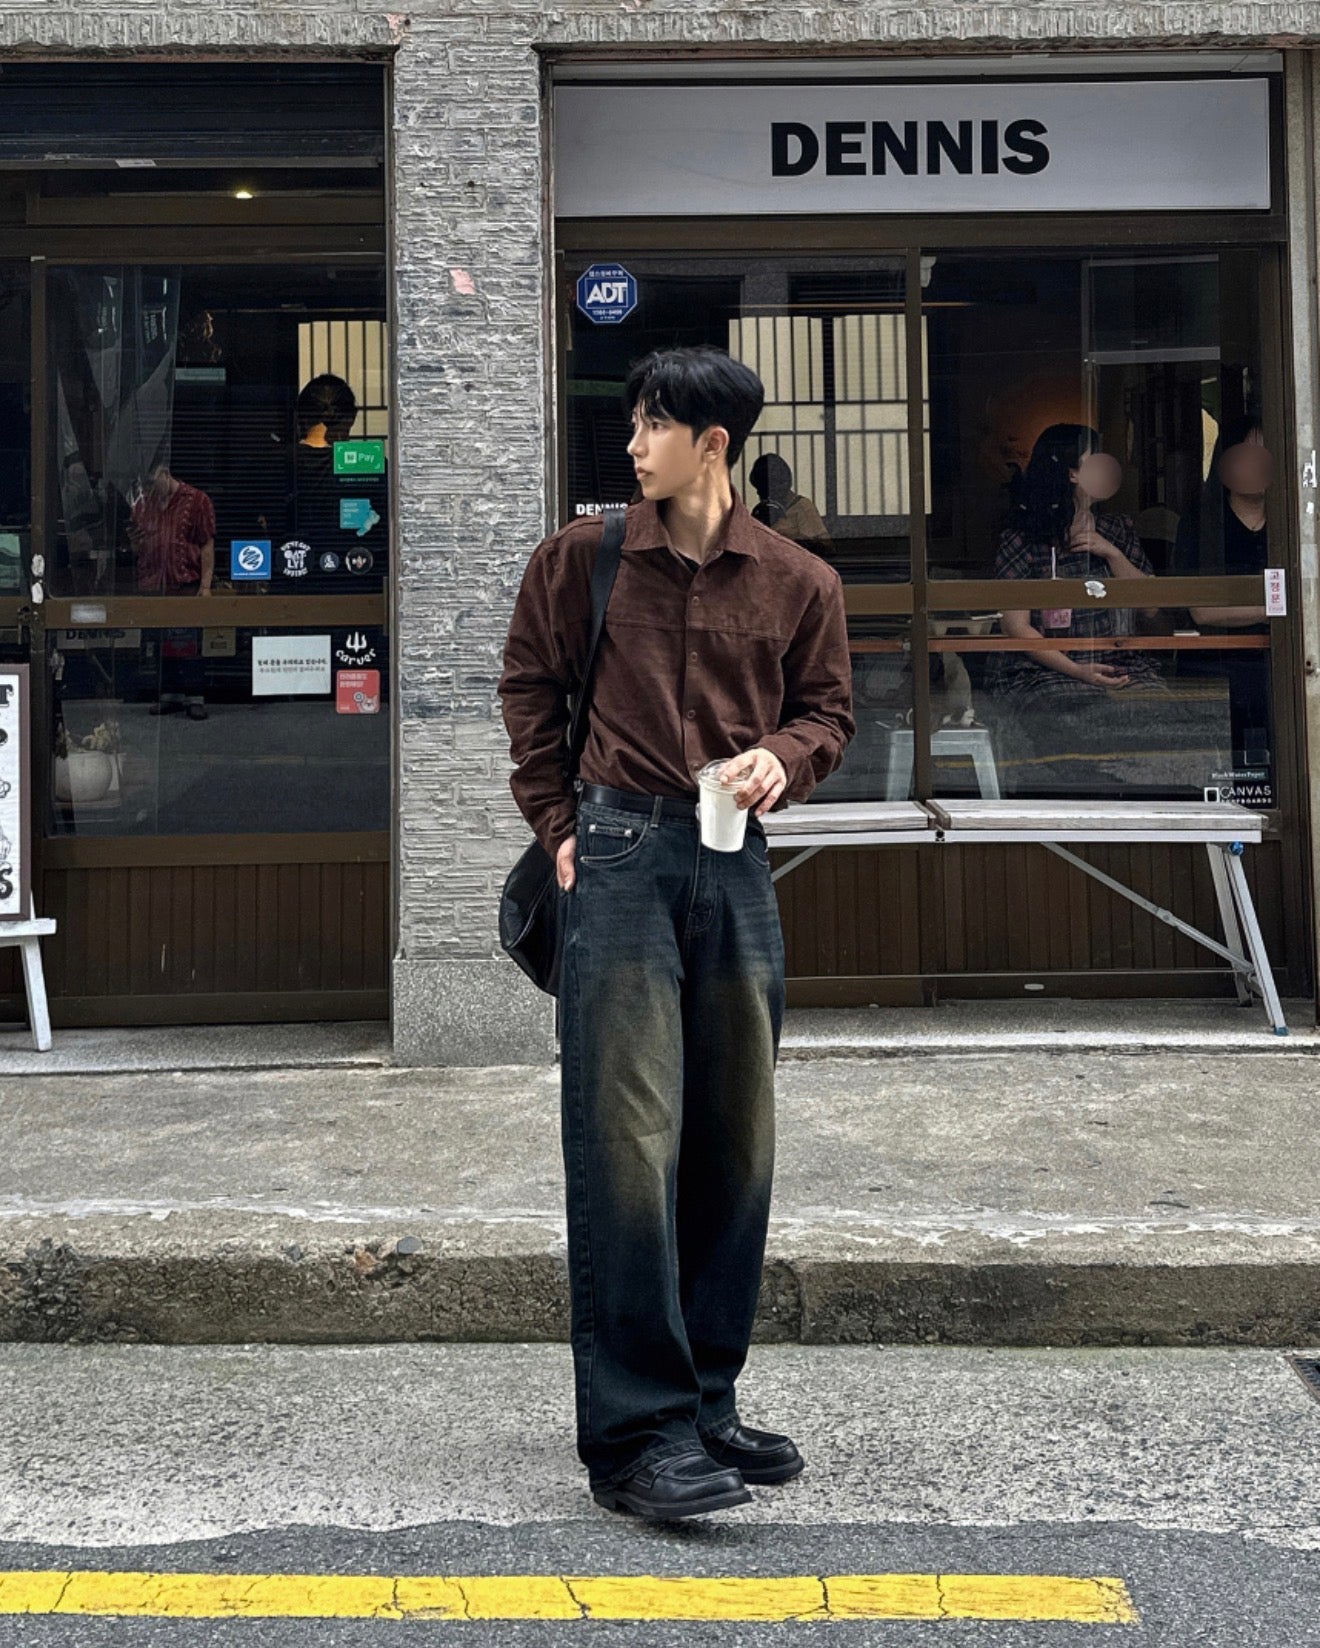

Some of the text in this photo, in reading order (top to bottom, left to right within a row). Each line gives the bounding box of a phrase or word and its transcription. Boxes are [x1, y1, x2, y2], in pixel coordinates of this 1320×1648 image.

[771, 119, 1050, 177] DENNIS
[586, 282, 628, 304] ADT
[358, 453, 375, 464] Pay
[1220, 785, 1272, 799] CANVAS
